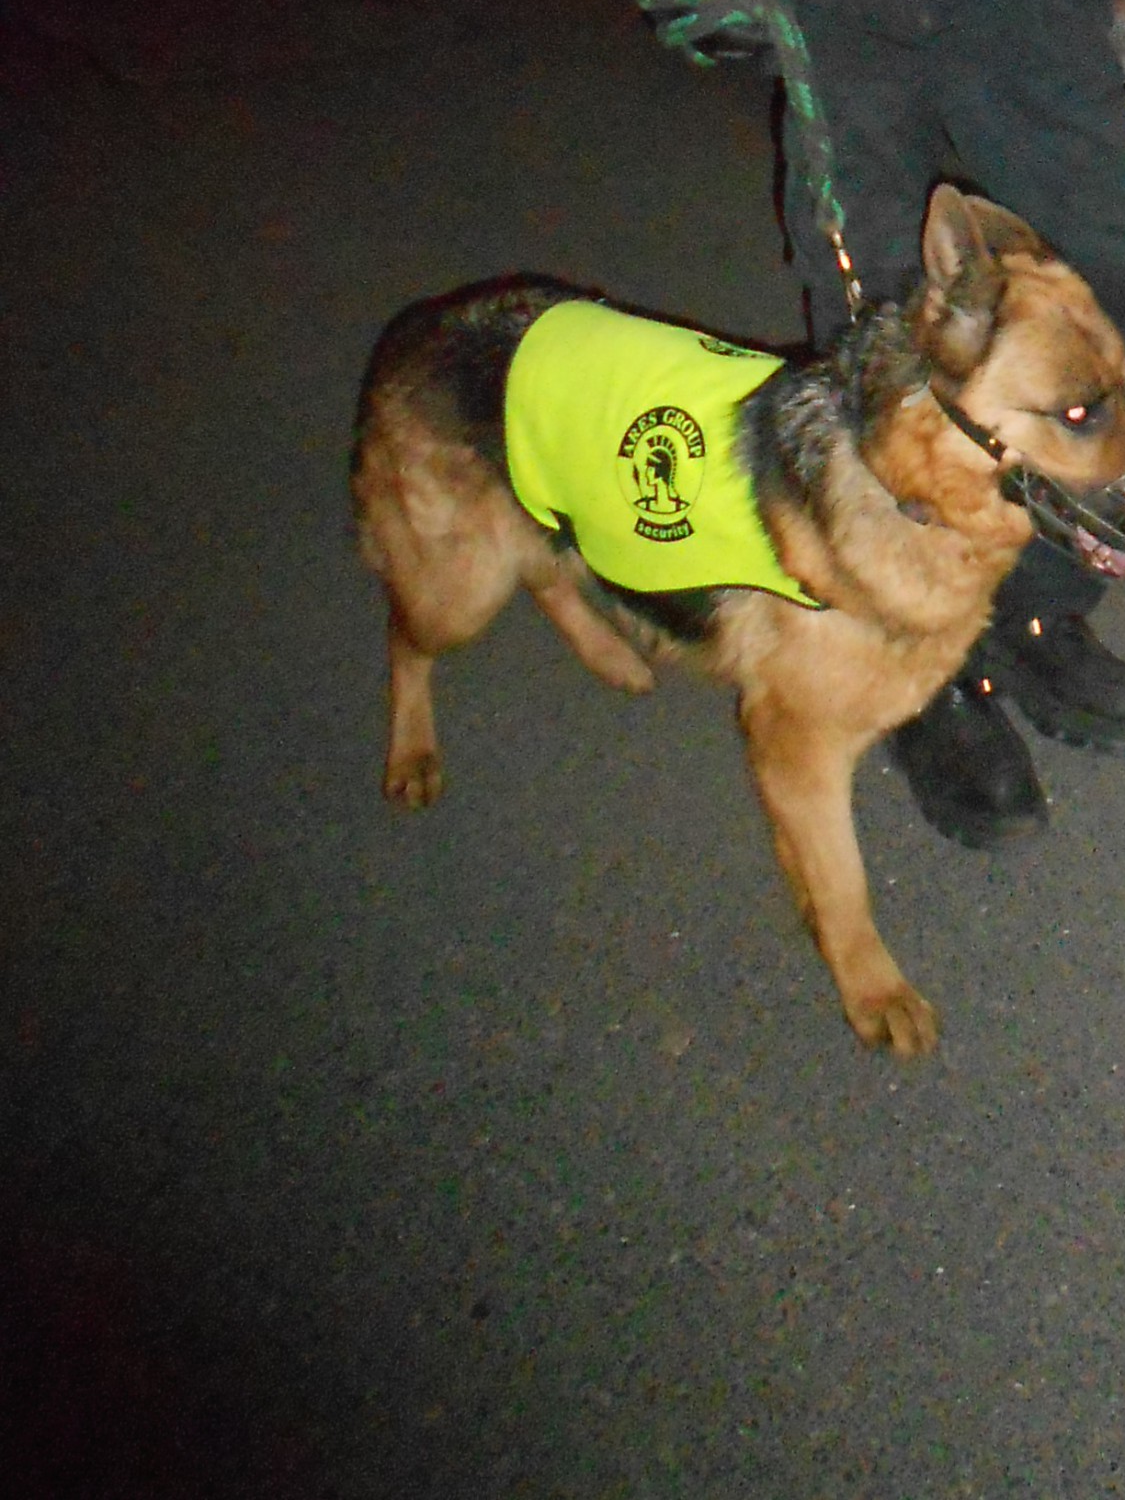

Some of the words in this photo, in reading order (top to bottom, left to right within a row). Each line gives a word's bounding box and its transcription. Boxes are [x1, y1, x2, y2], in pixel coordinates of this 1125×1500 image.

[622, 410, 658, 455] ARES
[662, 408, 703, 456] GROUP
[637, 522, 690, 539] security
